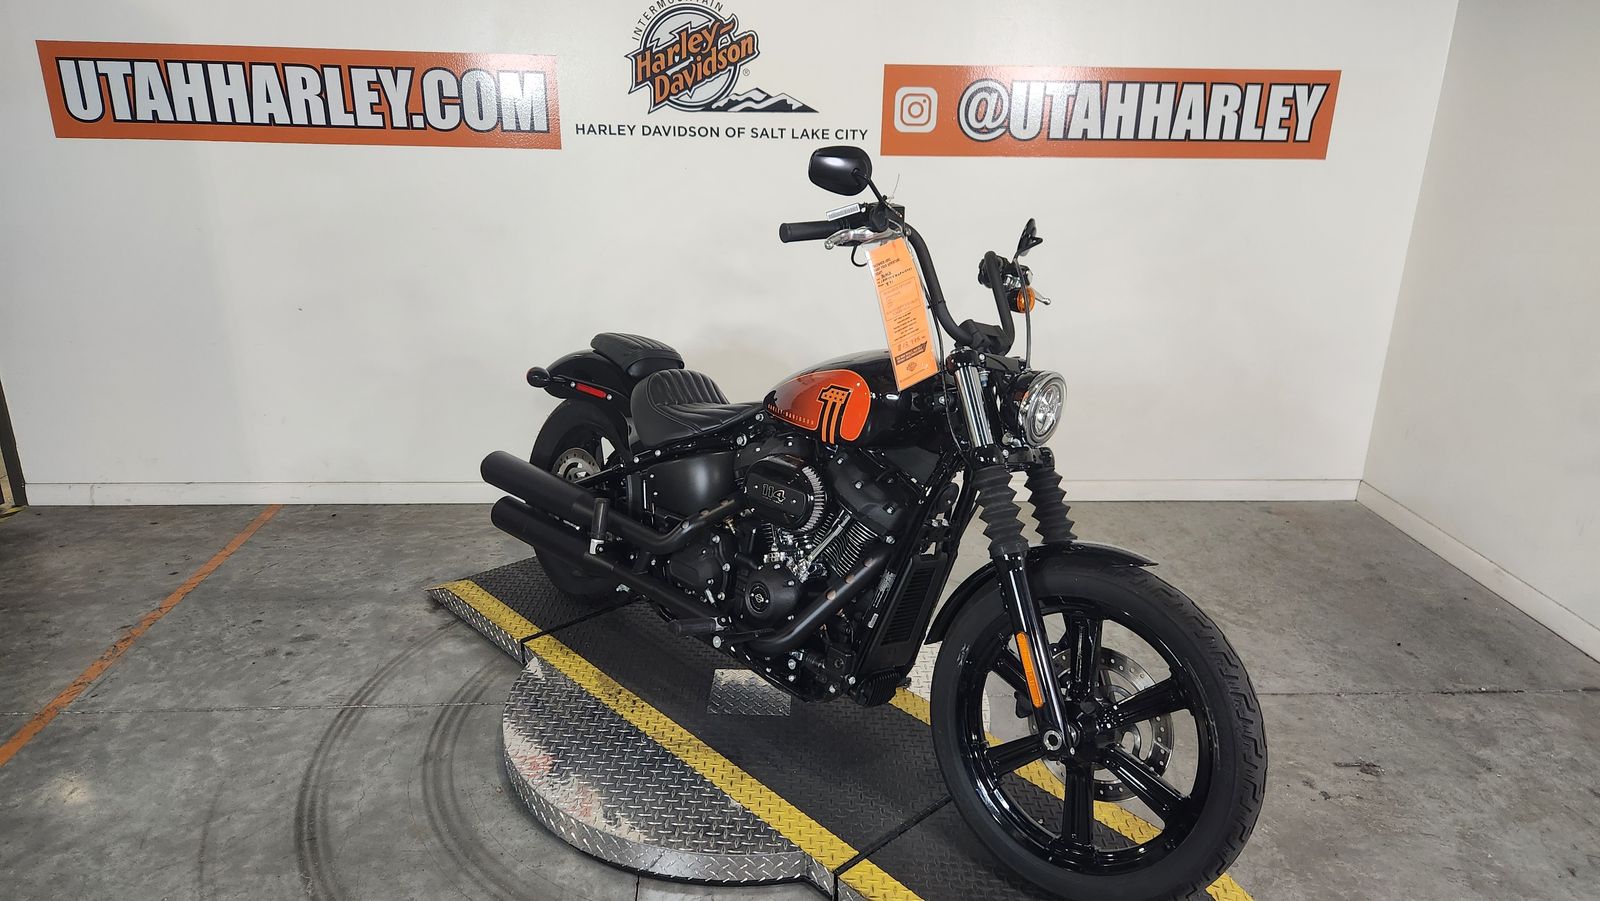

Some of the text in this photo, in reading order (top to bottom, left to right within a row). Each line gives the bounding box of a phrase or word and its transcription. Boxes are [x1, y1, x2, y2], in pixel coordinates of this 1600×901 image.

[632, 0, 723, 41] INTERMAIN
[55, 57, 550, 134] UTAHHARLEY.COM
[654, 36, 754, 104] Davidson
[575, 123, 868, 141] HARLEY DAVIDSON OF SALT LAKE CITY
[957, 78, 1331, 143] @UTAHHARLEY
[762, 483, 786, 503] 114
